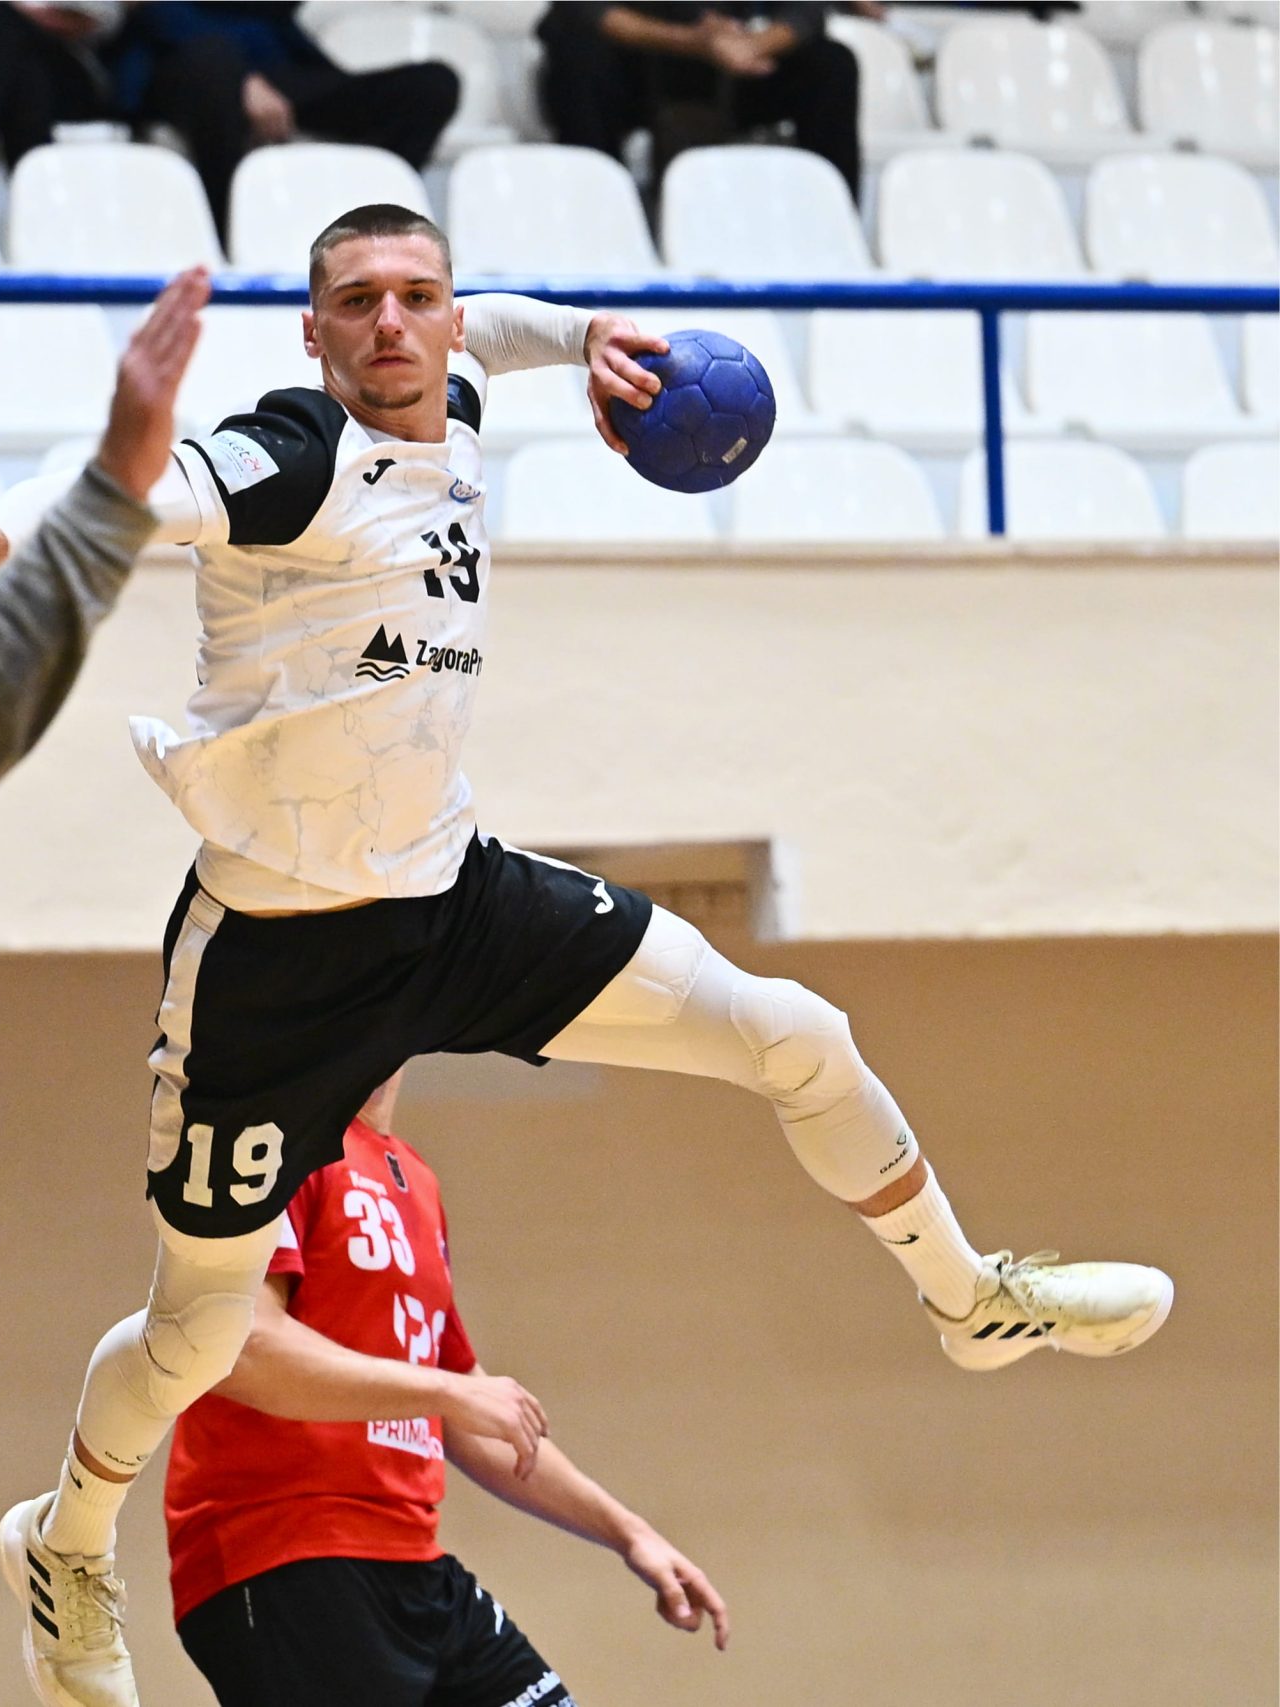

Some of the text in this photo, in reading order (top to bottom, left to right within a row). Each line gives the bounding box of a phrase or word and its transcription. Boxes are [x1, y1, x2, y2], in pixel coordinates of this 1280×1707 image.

[420, 521, 481, 604] 19
[182, 1121, 285, 1209] 19
[342, 1189, 417, 1277] 33
